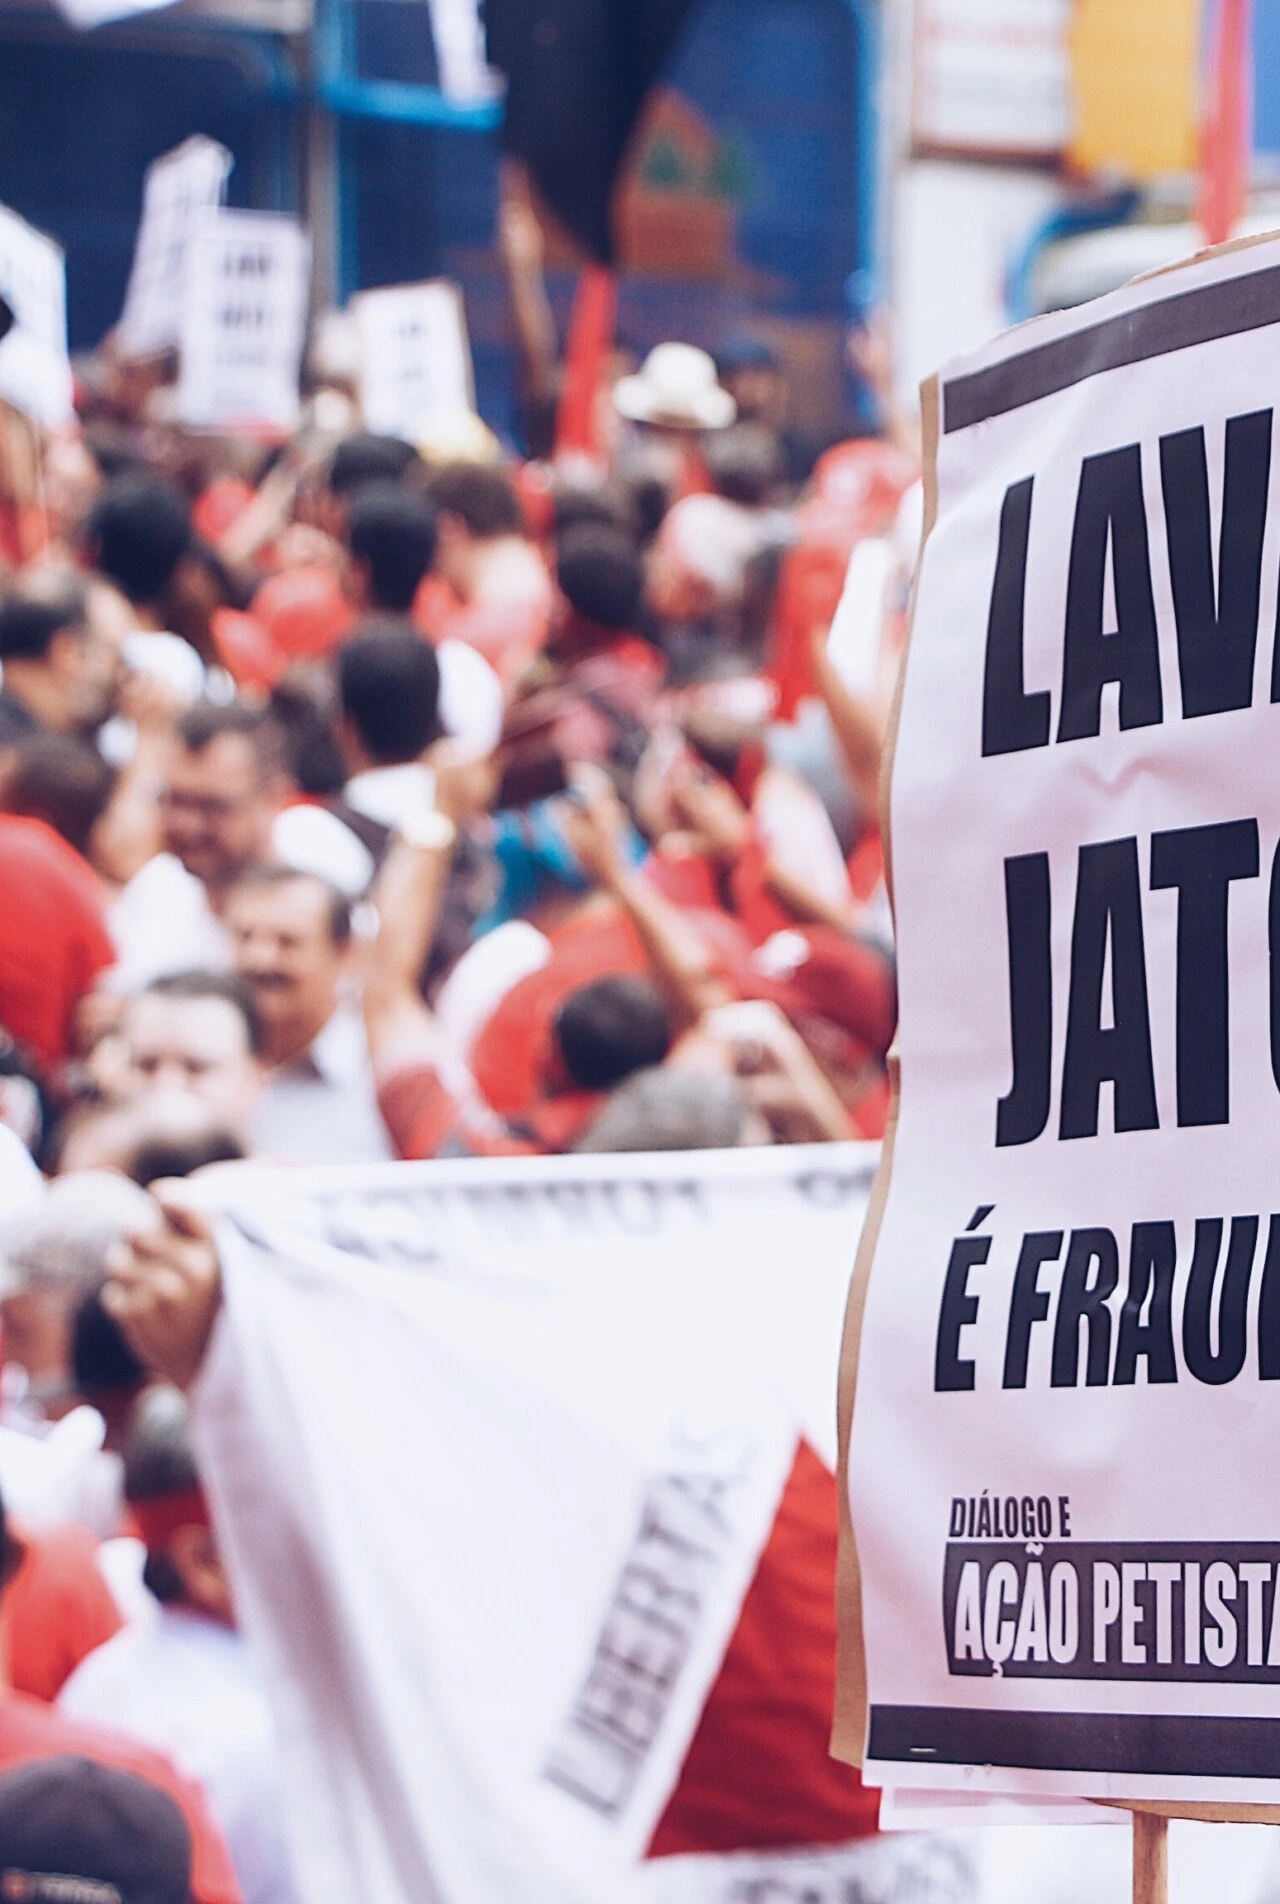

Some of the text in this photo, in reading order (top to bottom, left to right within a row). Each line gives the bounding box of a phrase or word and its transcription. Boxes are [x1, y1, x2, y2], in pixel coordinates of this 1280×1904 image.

[933, 1203, 995, 1393] É
[948, 1489, 1071, 1539] DIÁLOGO E
[954, 1541, 1079, 1678] AÇÃO
